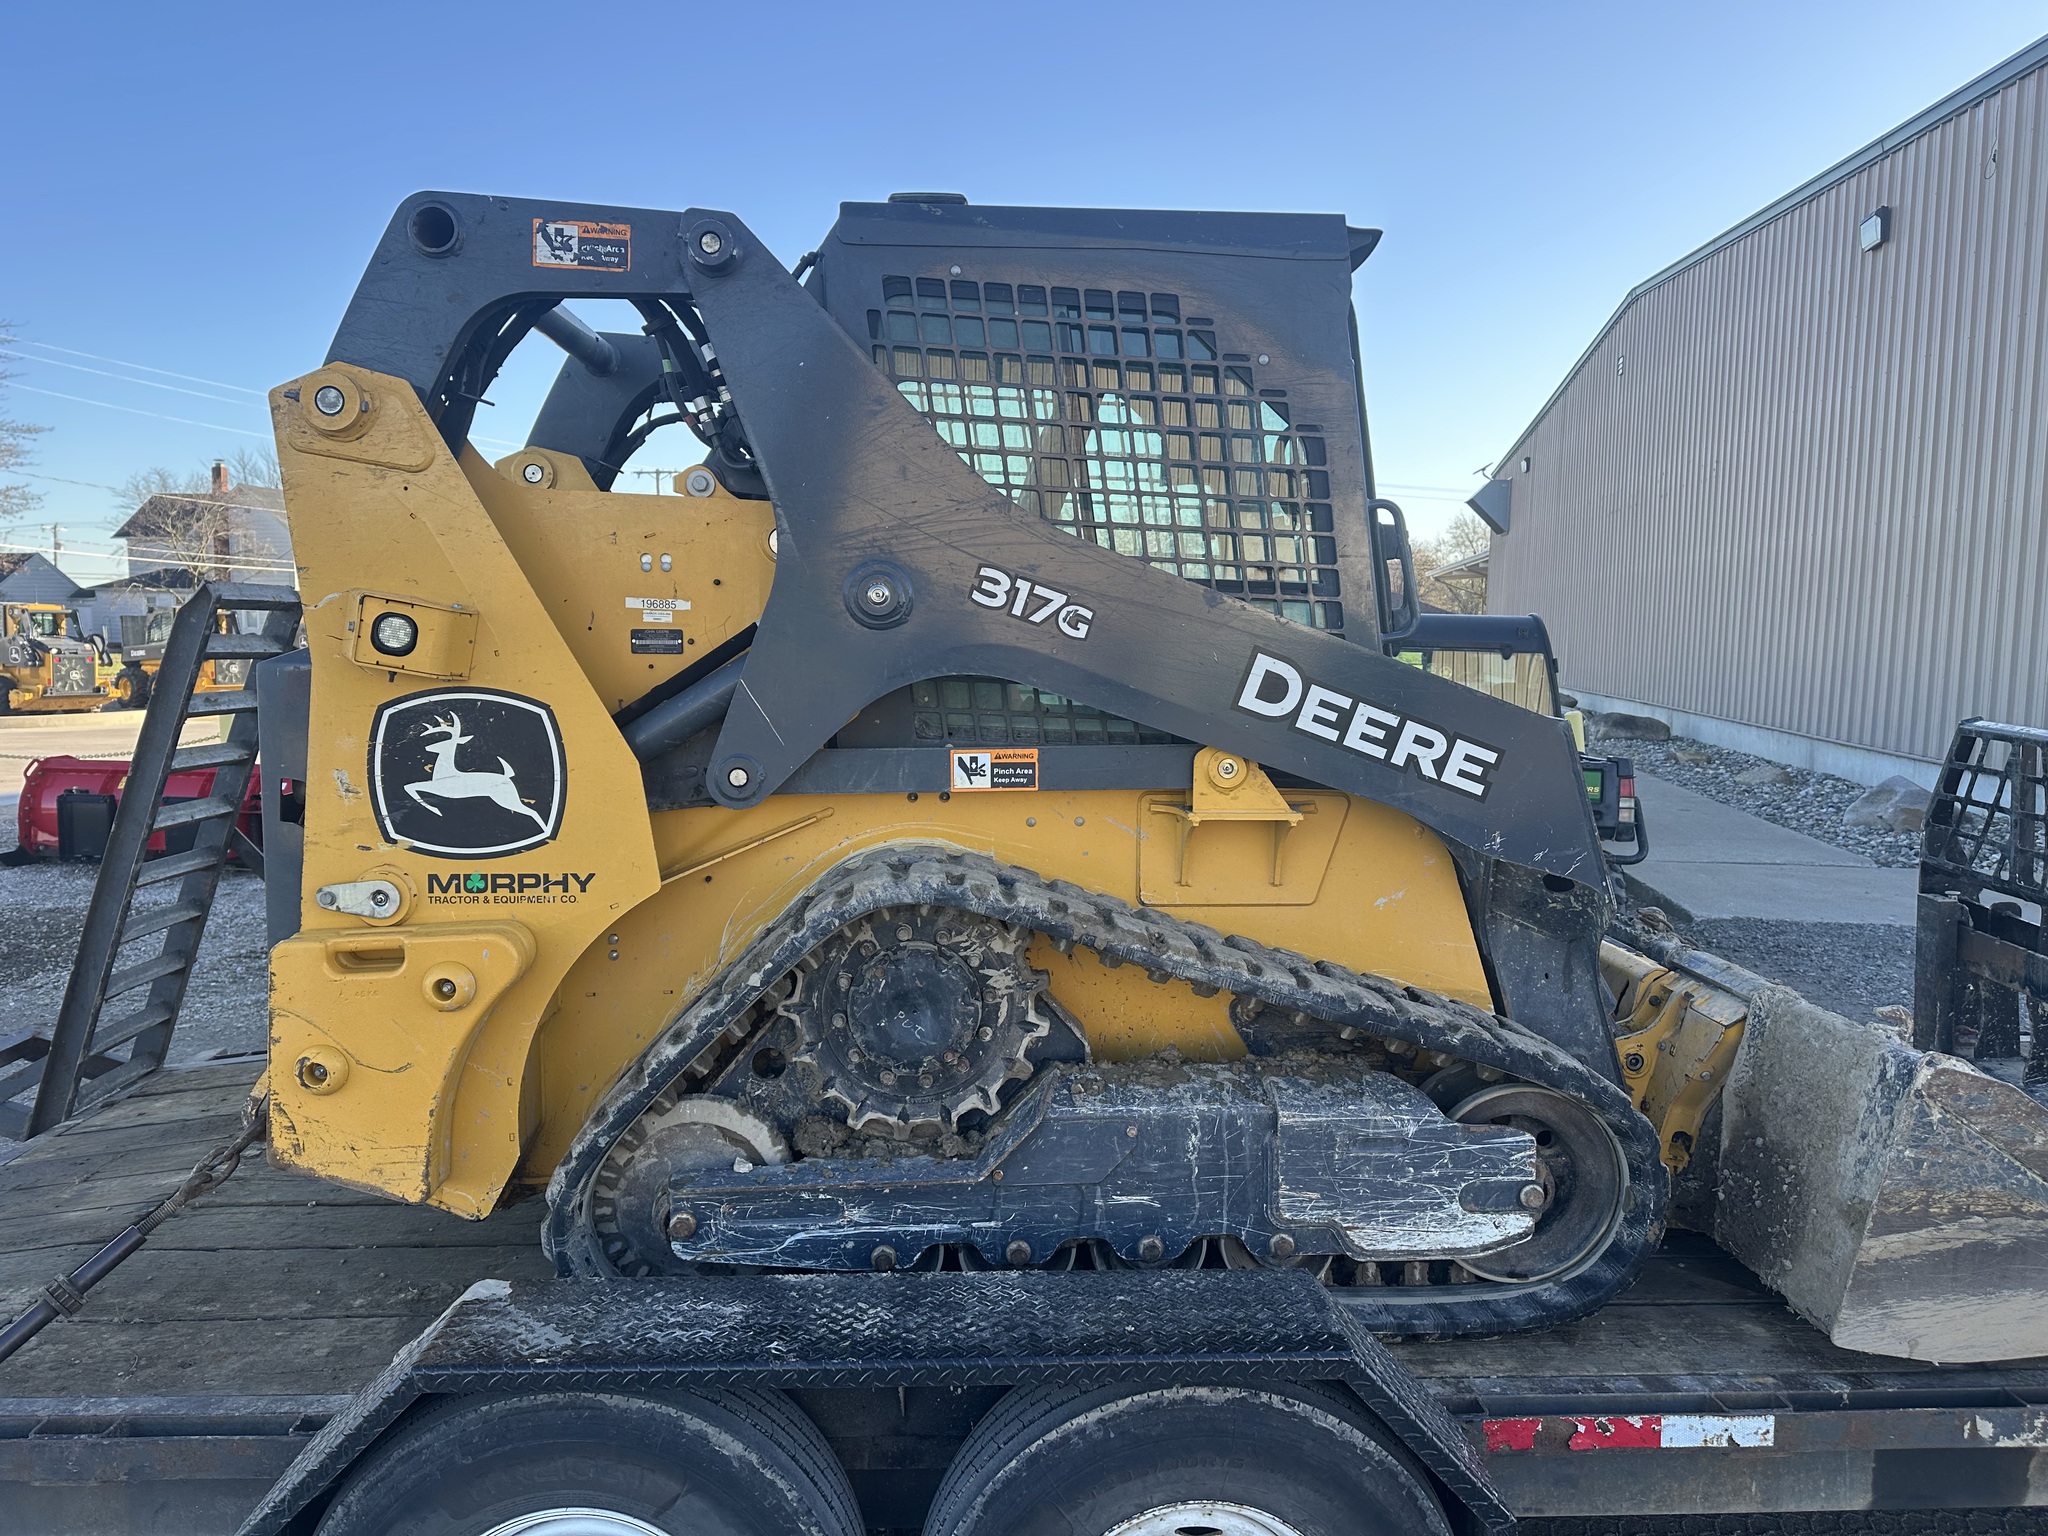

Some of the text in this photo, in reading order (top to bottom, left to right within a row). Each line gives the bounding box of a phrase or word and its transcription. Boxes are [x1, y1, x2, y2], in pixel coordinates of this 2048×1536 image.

[641, 600, 676, 609] 196885
[971, 567, 1093, 639] 317G
[1238, 653, 1498, 796] DEERE
[428, 873, 596, 894] MURPHY
[428, 895, 579, 904] TRACTOR & EQUIPMENT CO.
